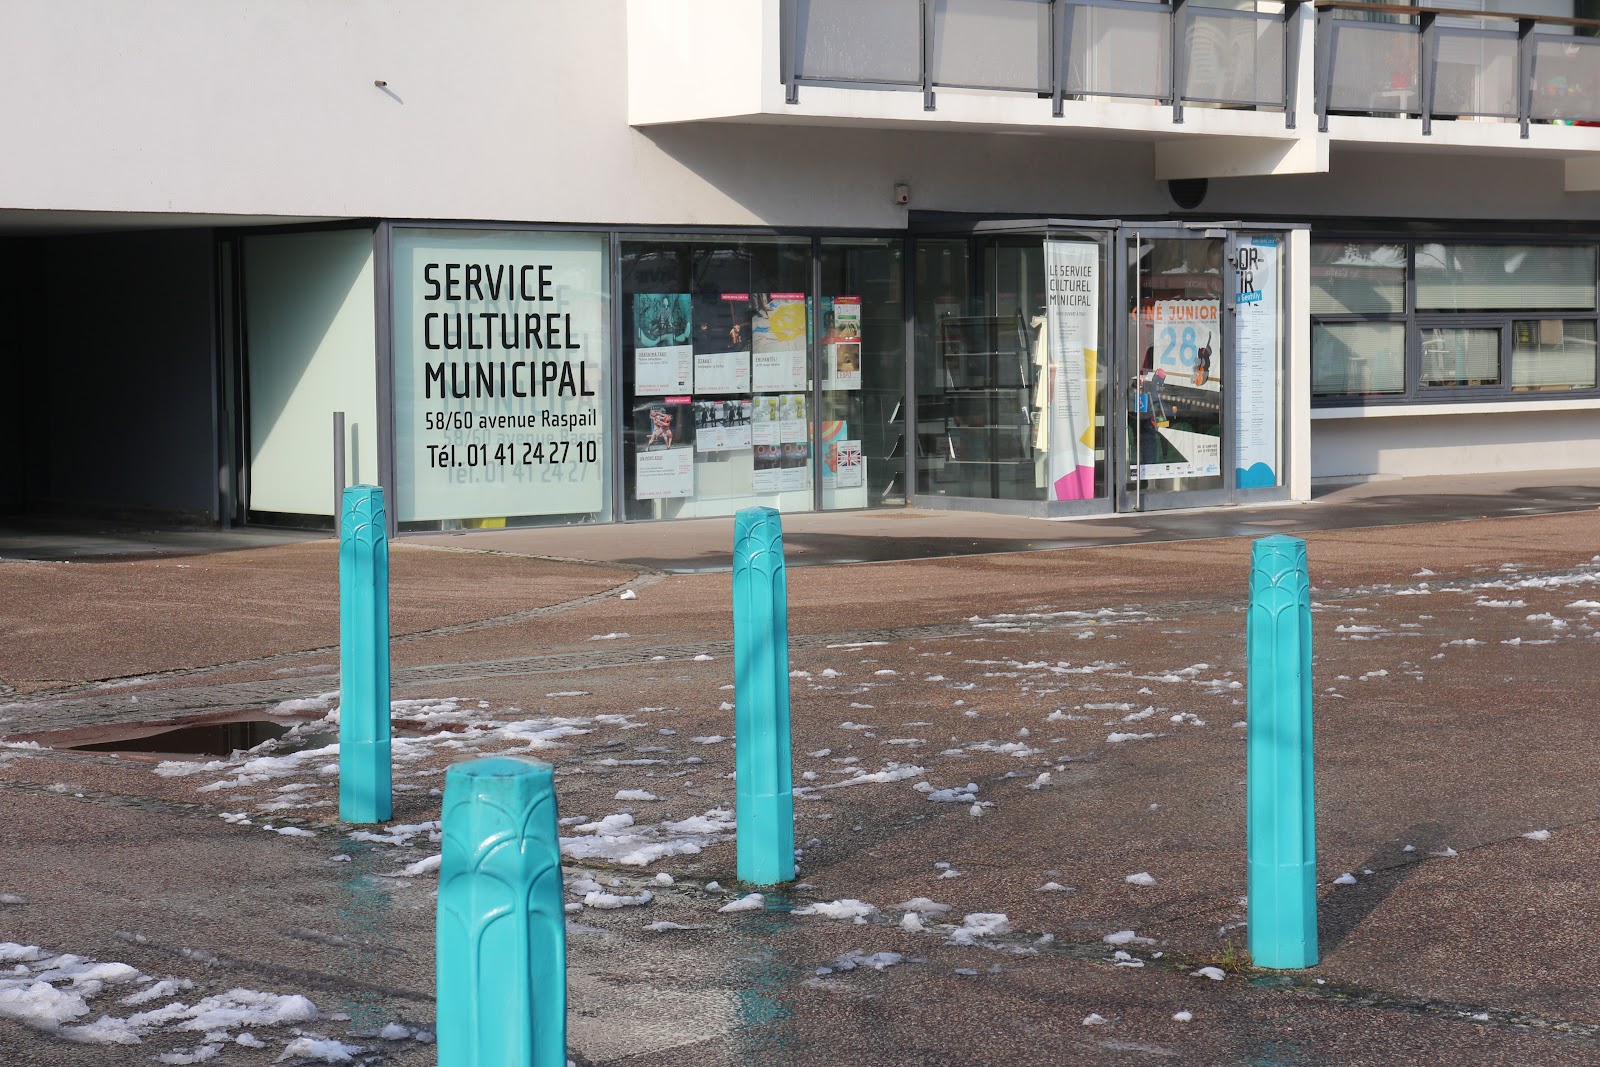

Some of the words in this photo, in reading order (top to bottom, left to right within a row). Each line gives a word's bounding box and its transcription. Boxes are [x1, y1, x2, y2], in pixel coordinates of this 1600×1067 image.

[424, 263, 554, 302] SERVICE
[1049, 264, 1058, 277] LE
[1060, 265, 1092, 278] SERVICE
[1049, 279, 1092, 293] CULTUREL
[1168, 305, 1218, 320] JUNIOR
[424, 312, 581, 350] CULTUREL
[1159, 326, 1198, 366] 28
[425, 360, 595, 399] MUNICIPAL
[425, 411, 473, 431] 58/60
[478, 415, 536, 429] avenue
[541, 408, 597, 432] Raspail
[494, 442, 514, 466] 41
[522, 441, 545, 465] 24
[549, 441, 570, 464] 27
[576, 440, 597, 463] 10
